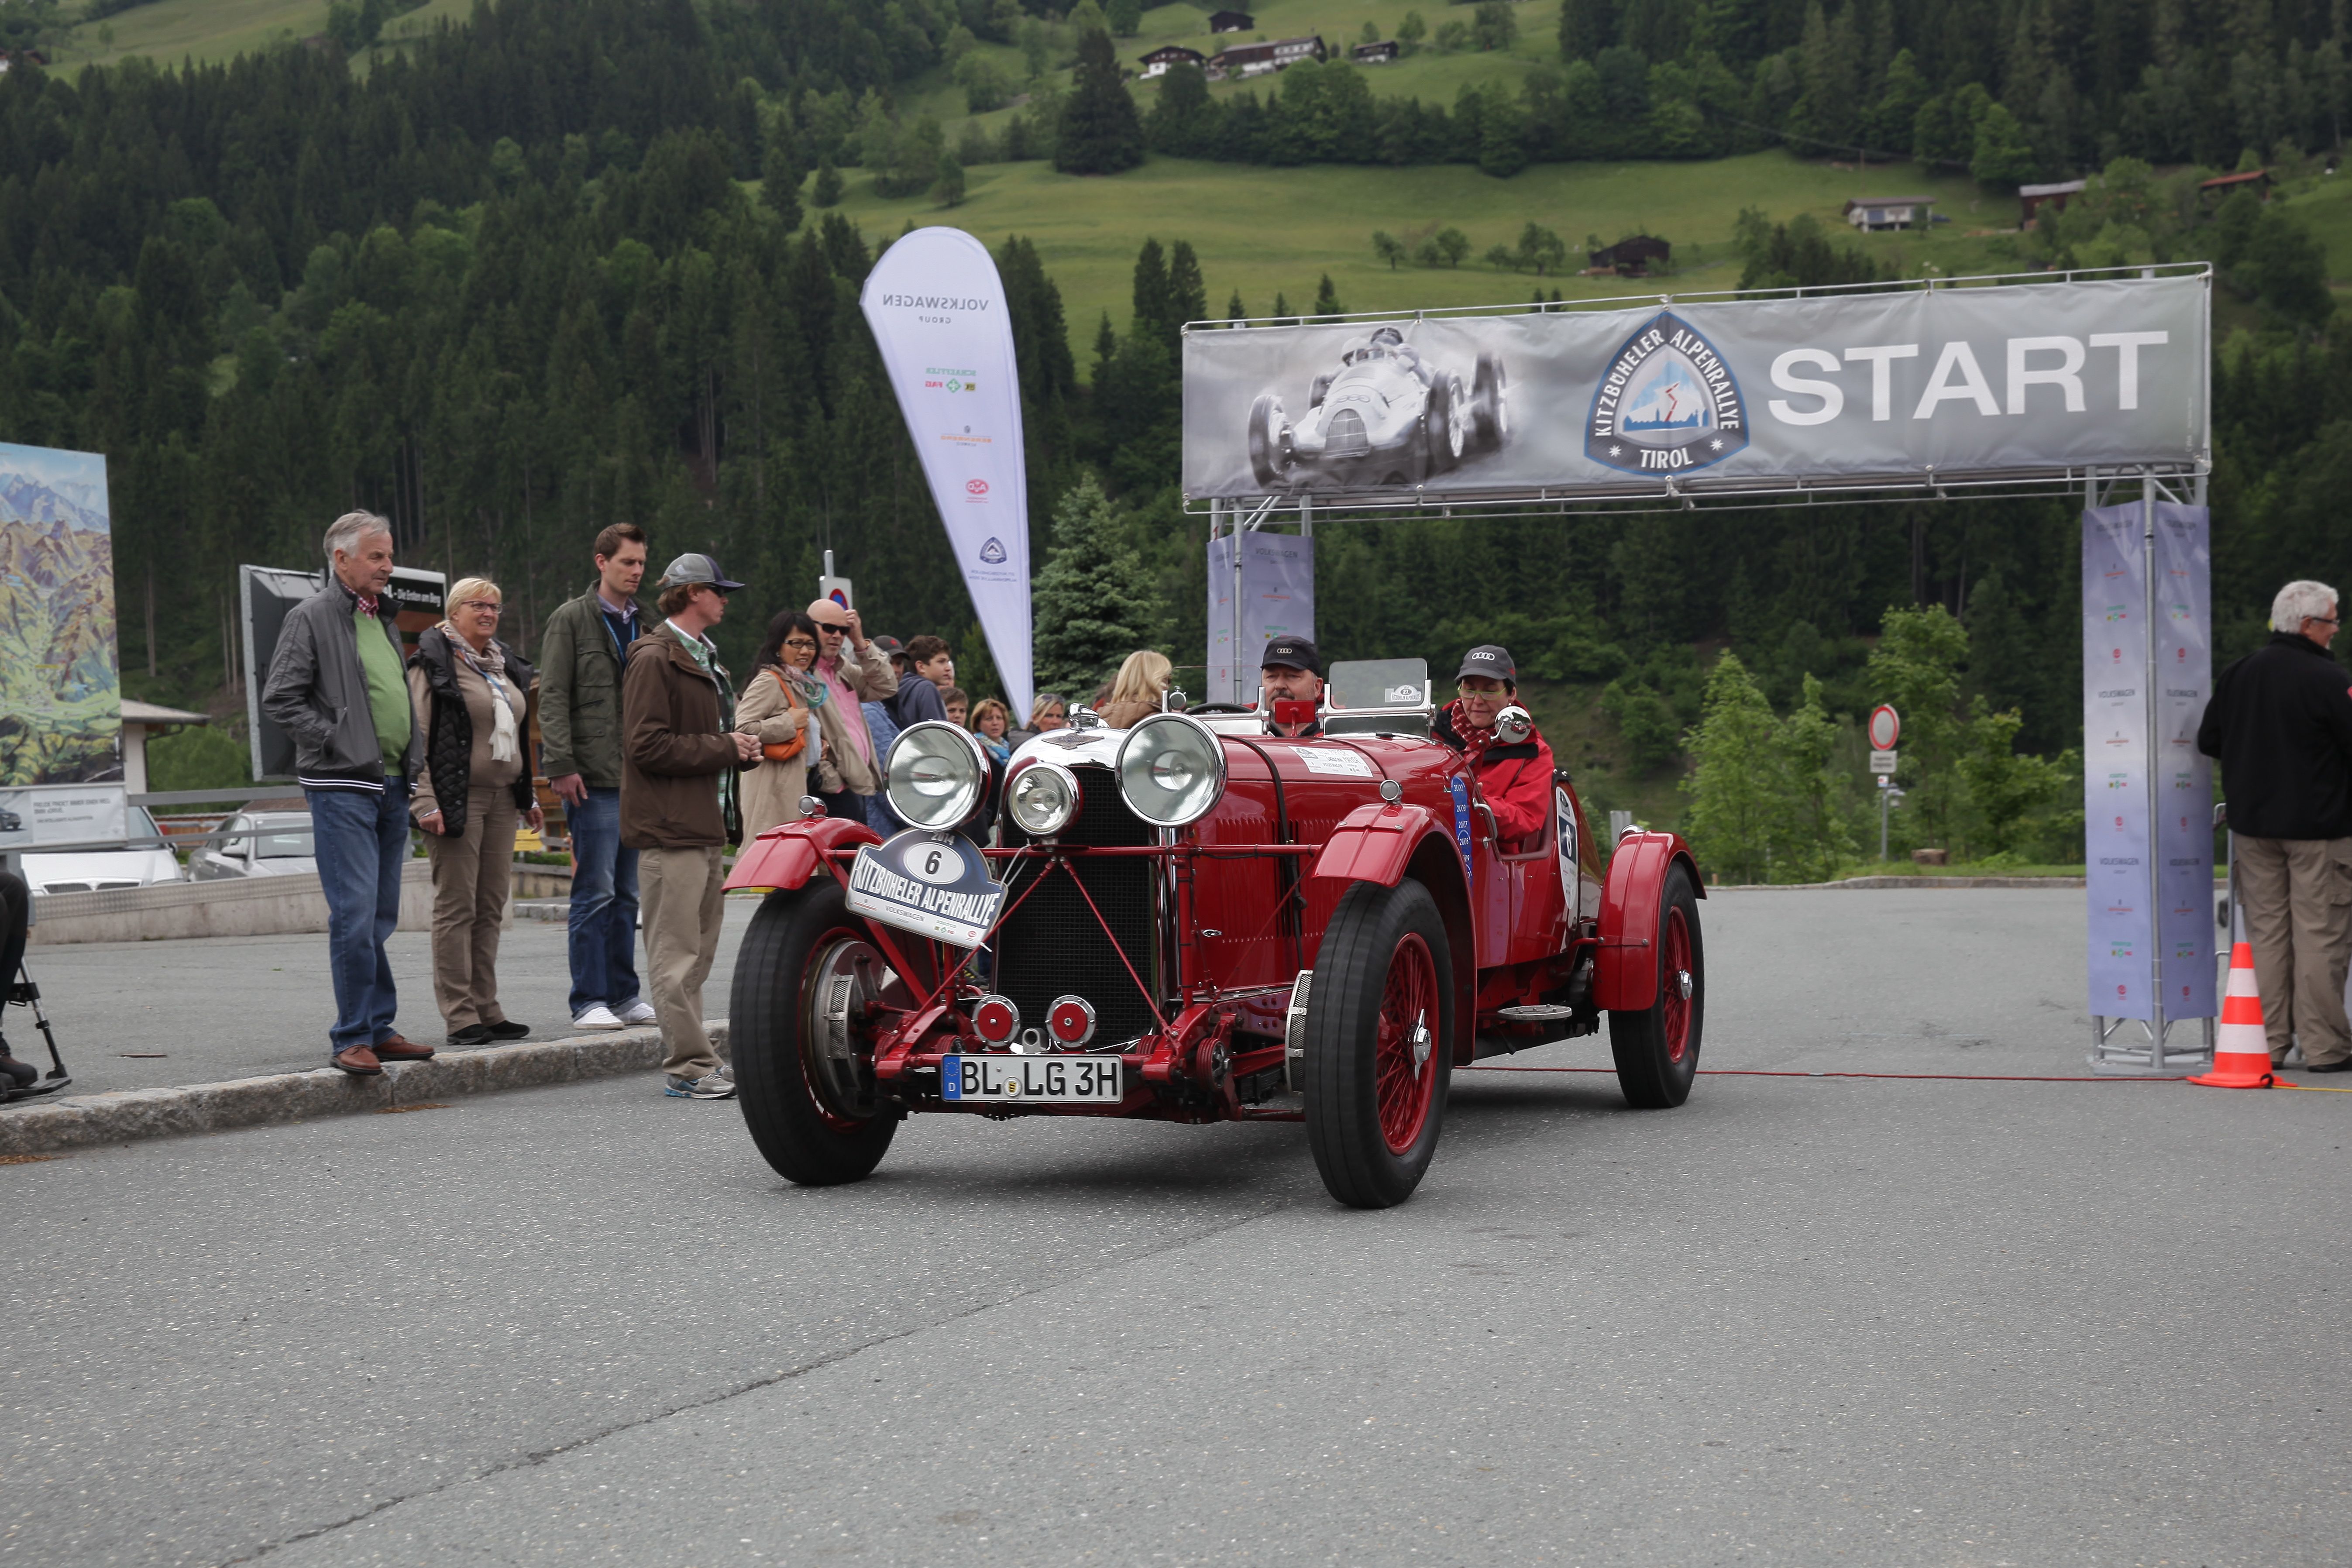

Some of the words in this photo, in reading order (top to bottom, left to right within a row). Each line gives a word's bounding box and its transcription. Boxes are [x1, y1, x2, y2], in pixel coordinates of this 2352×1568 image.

[1595, 329, 1665, 436] KITZBÜHELER
[1669, 329, 1739, 430] ALPENRALLYE
[1768, 330, 2169, 426] START
[1640, 447, 1694, 469] TIROL
[1457, 804, 1466, 812] 2003
[931, 831, 955, 846] 2014
[1460, 837, 1469, 846] 2008
[925, 850, 942, 875] 6
[920, 886, 1001, 926] ALPENRALLYE
[948, 1082, 956, 1093] D
[961, 1061, 1001, 1095] BL
[1023, 1062, 1066, 1096] LG
[1075, 1062, 1118, 1096] 3H
